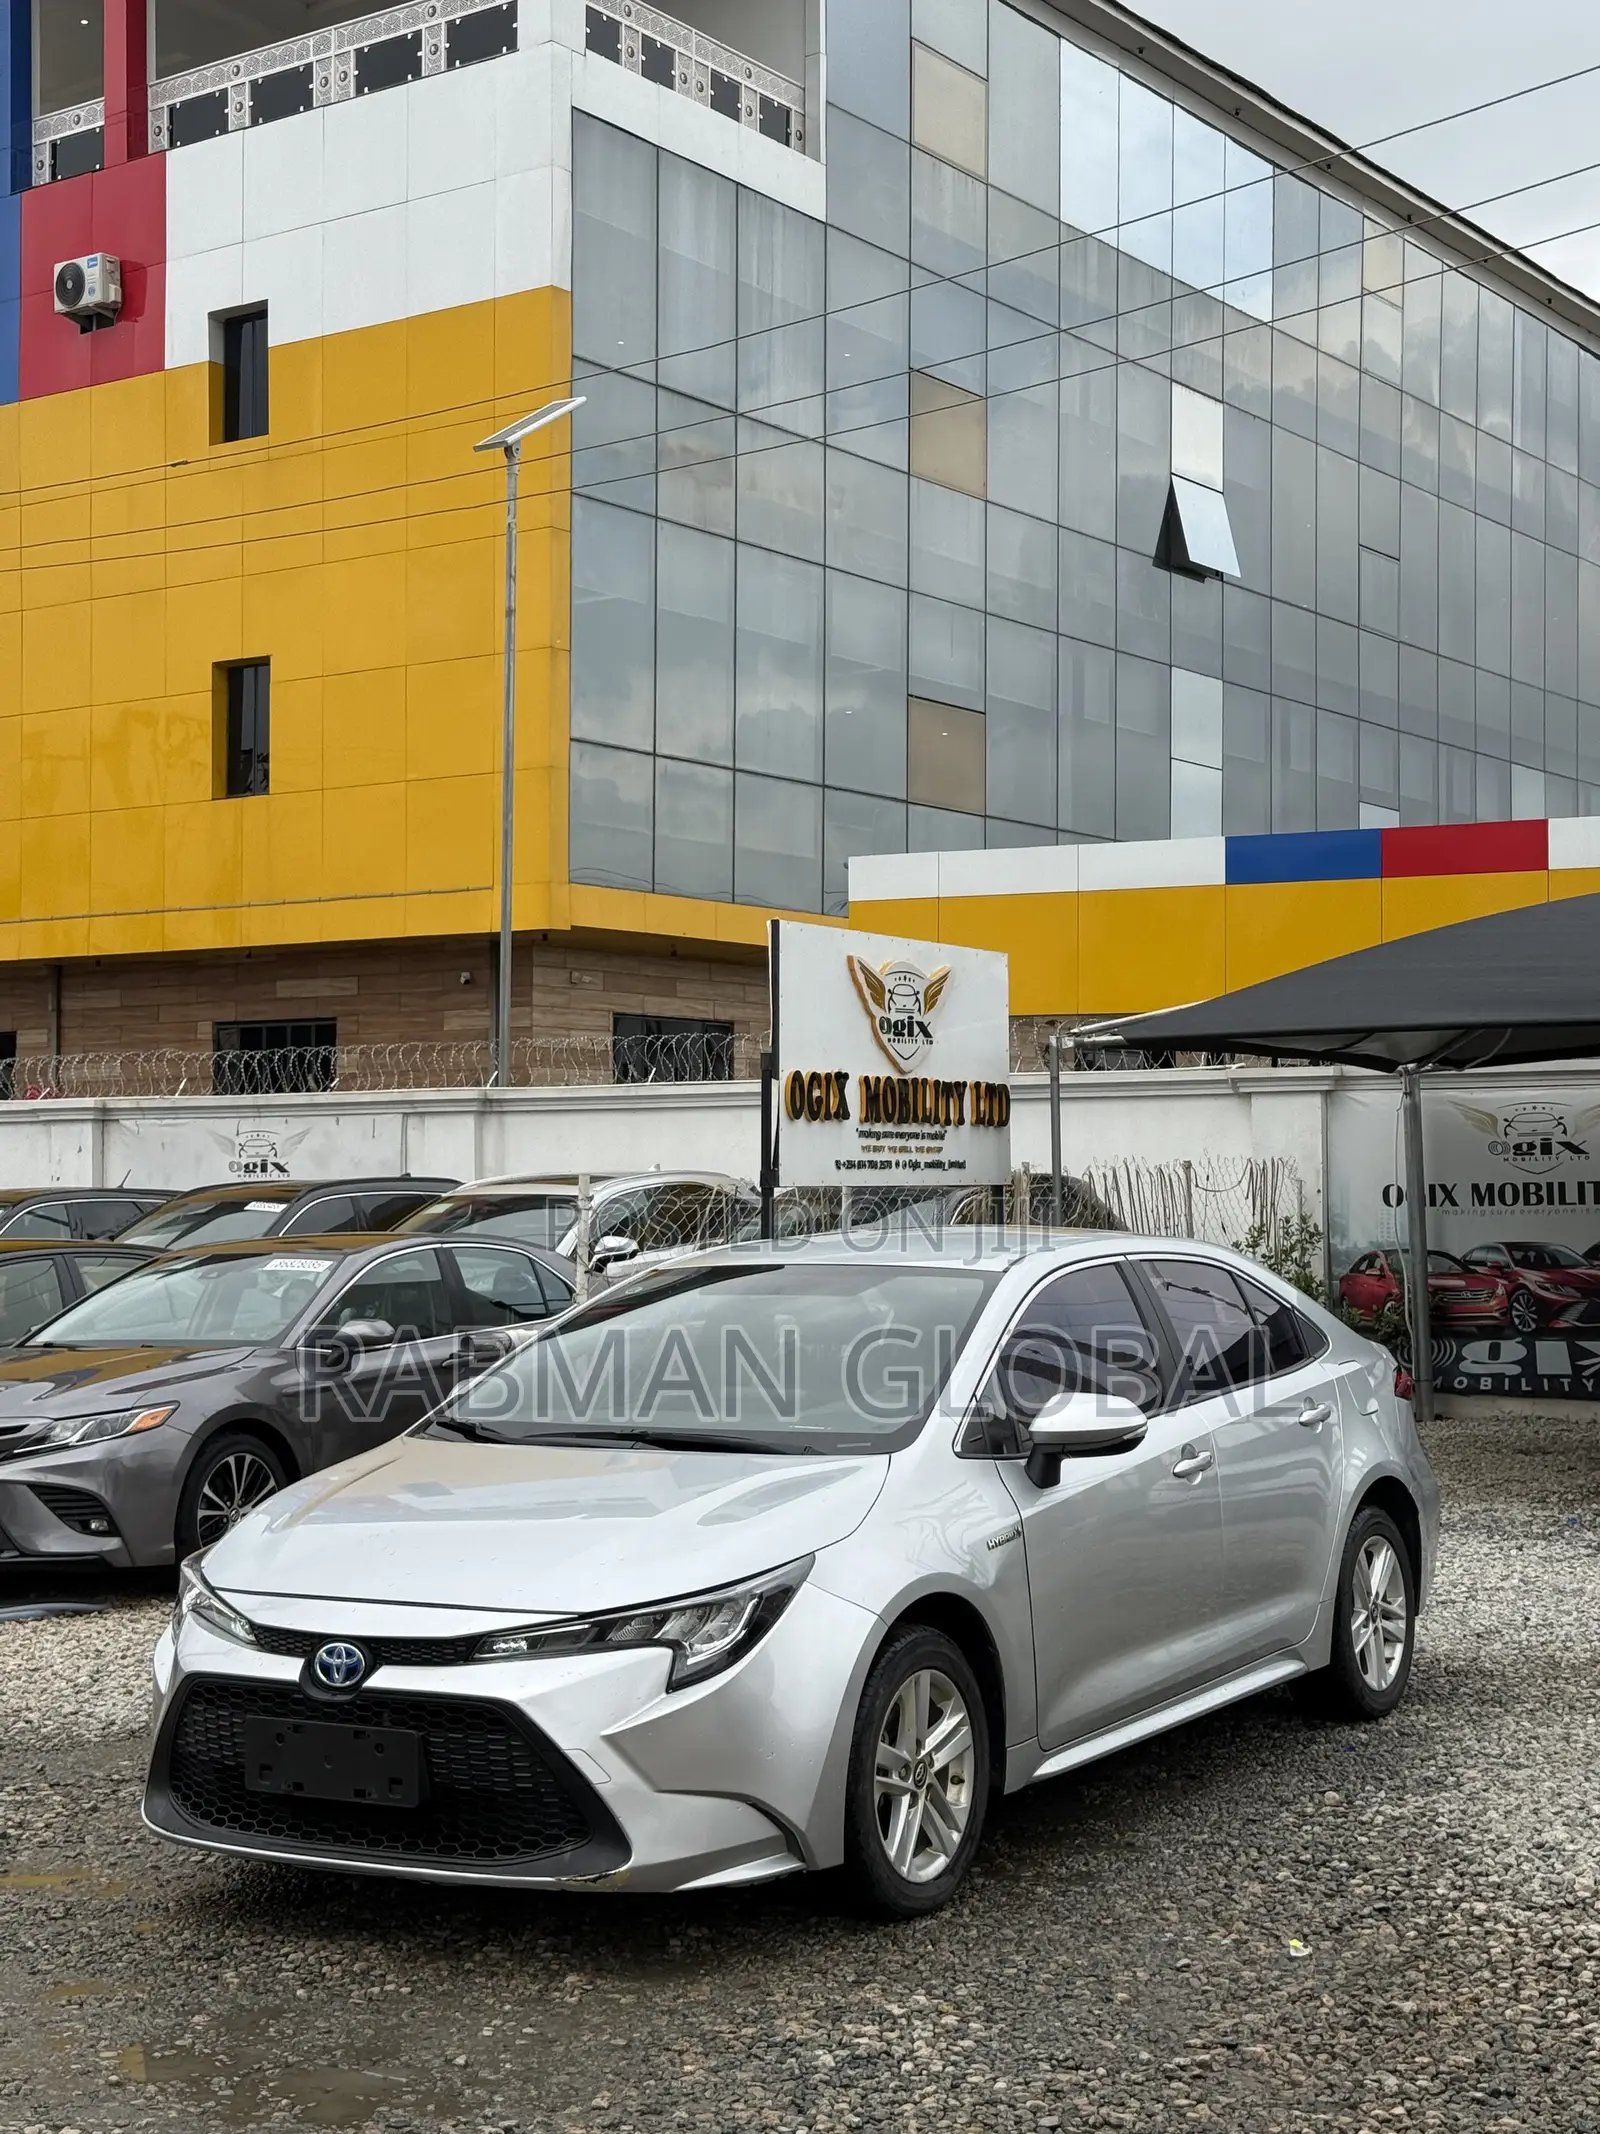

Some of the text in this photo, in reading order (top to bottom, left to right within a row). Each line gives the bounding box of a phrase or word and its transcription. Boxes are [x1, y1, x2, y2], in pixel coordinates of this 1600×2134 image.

[785, 1070, 1010, 1127] OGIX MOBILITY LTD
[1382, 1183, 1460, 1208] OIX
